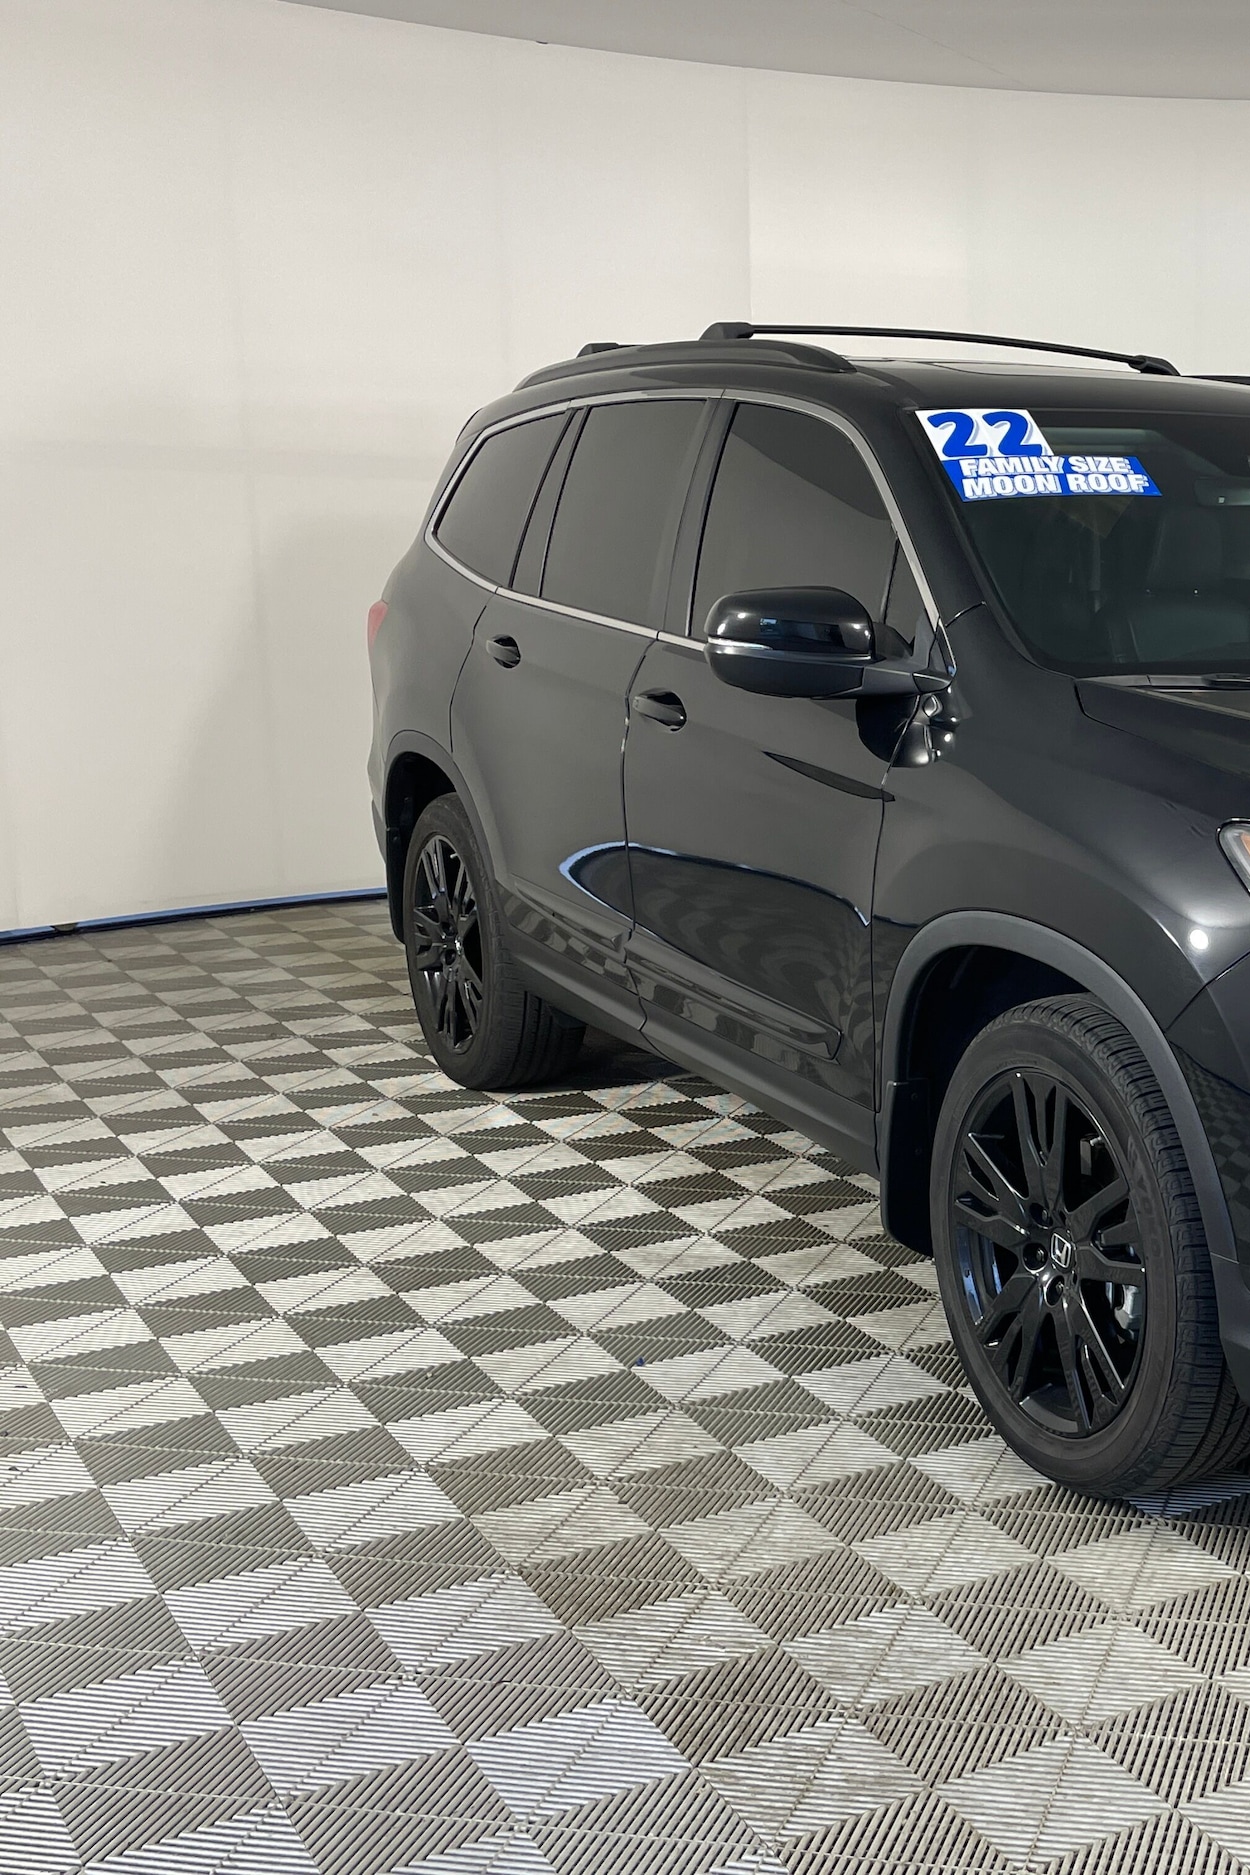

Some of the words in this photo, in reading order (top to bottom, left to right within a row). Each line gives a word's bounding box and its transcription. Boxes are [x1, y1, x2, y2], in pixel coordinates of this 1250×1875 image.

[927, 411, 1043, 457] 22
[960, 456, 1064, 477] FAMILY
[1068, 456, 1134, 474] SIZE
[962, 475, 1062, 499] MOON
[1067, 474, 1149, 493] ROOF
